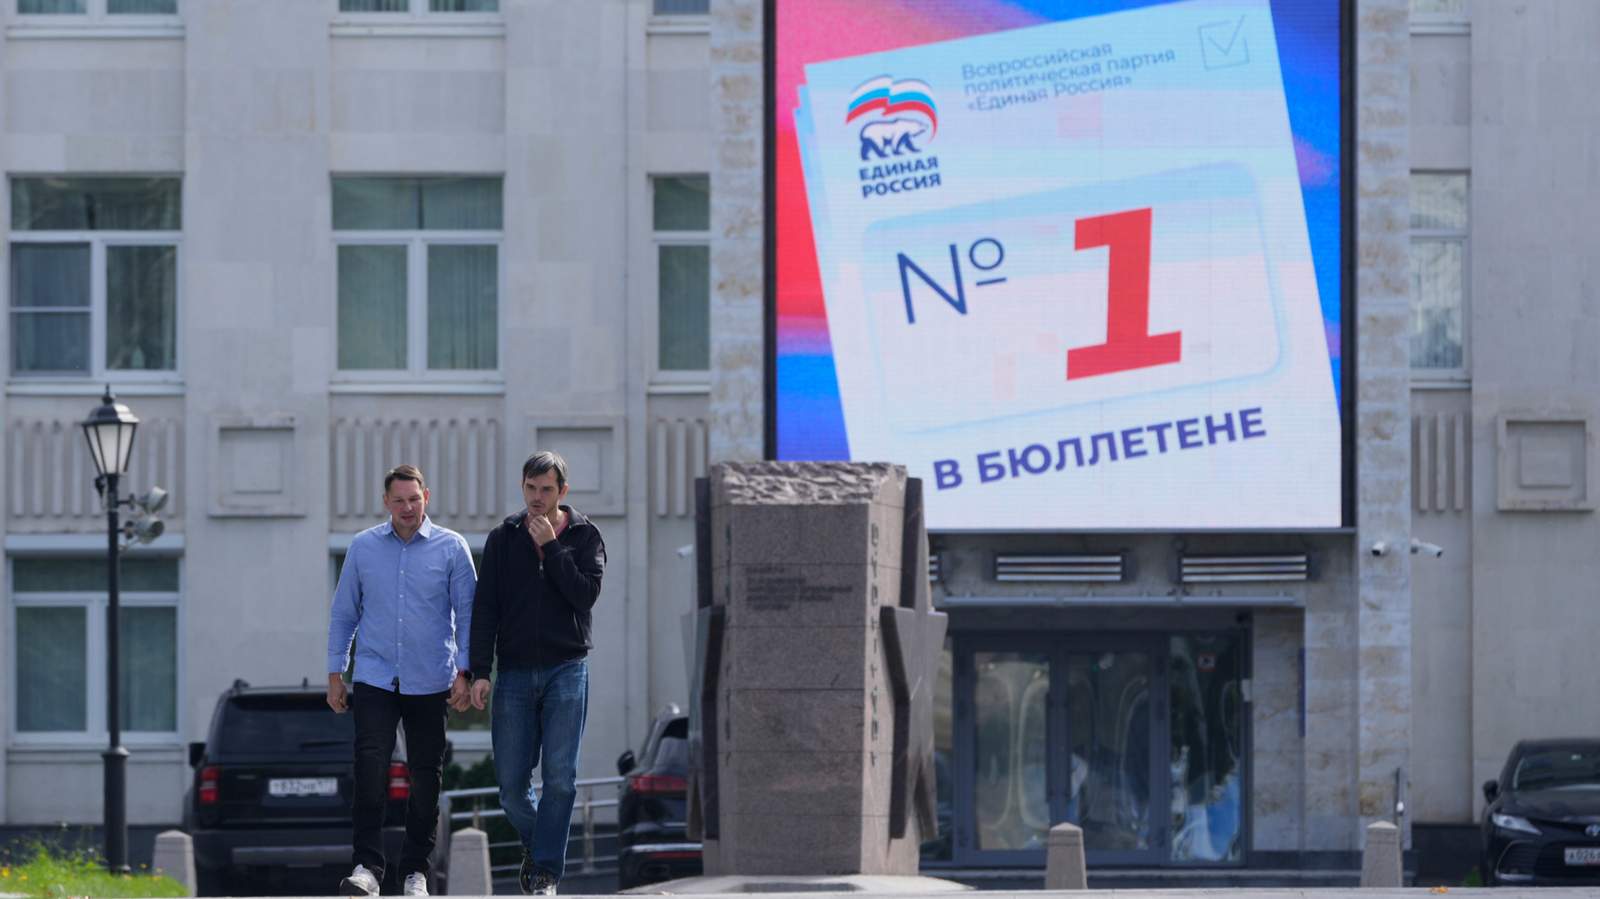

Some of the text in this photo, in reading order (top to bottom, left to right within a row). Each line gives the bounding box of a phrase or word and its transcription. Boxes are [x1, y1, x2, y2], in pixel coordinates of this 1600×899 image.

[962, 43, 1113, 81] Всероссийская
[964, 49, 1176, 96] политическая партия
[859, 156, 939, 182] ЕДИНАЯ
[862, 173, 942, 198] РОССИЯ
[1066, 207, 1182, 381] 1
[933, 407, 1267, 491] В БЮЛЛЕТЕНЕ
